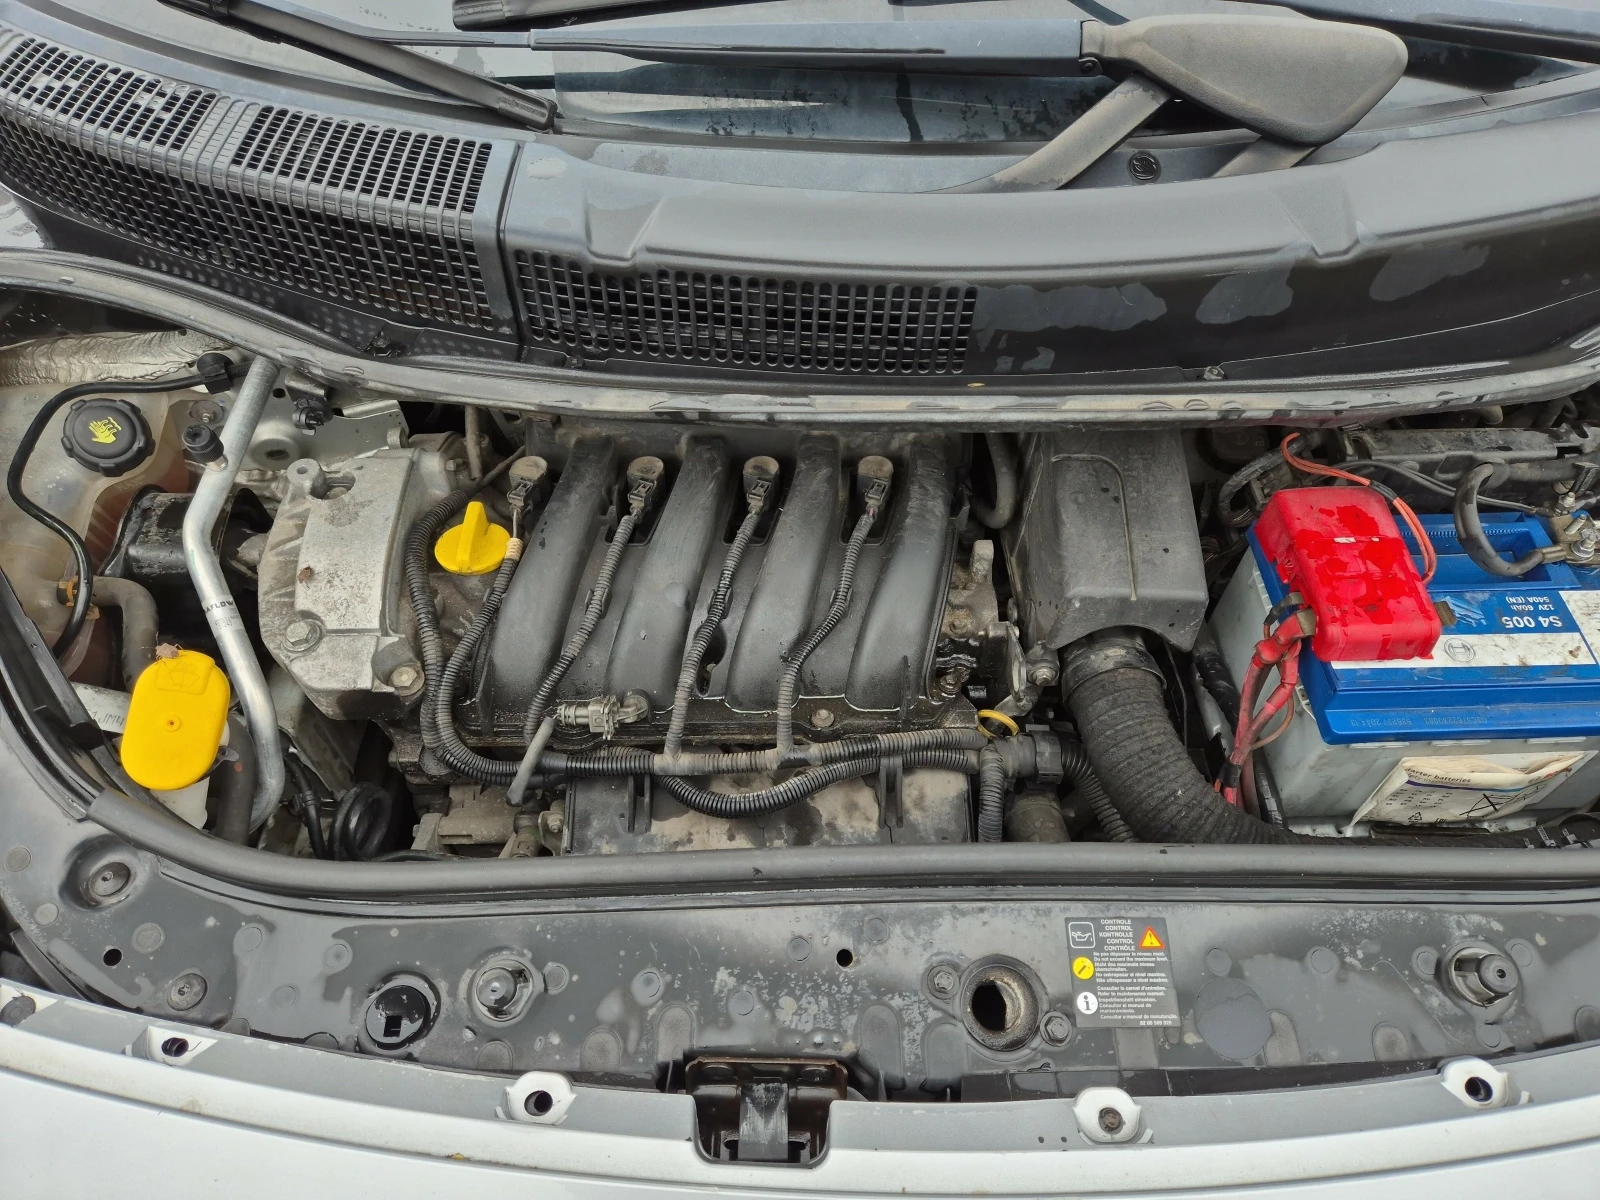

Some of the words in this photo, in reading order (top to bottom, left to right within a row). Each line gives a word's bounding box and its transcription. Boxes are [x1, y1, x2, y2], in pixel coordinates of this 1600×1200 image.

[1502, 616, 1535, 628] 005
[1538, 616, 1562, 628] S4
[1434, 774, 1471, 783] batteries
